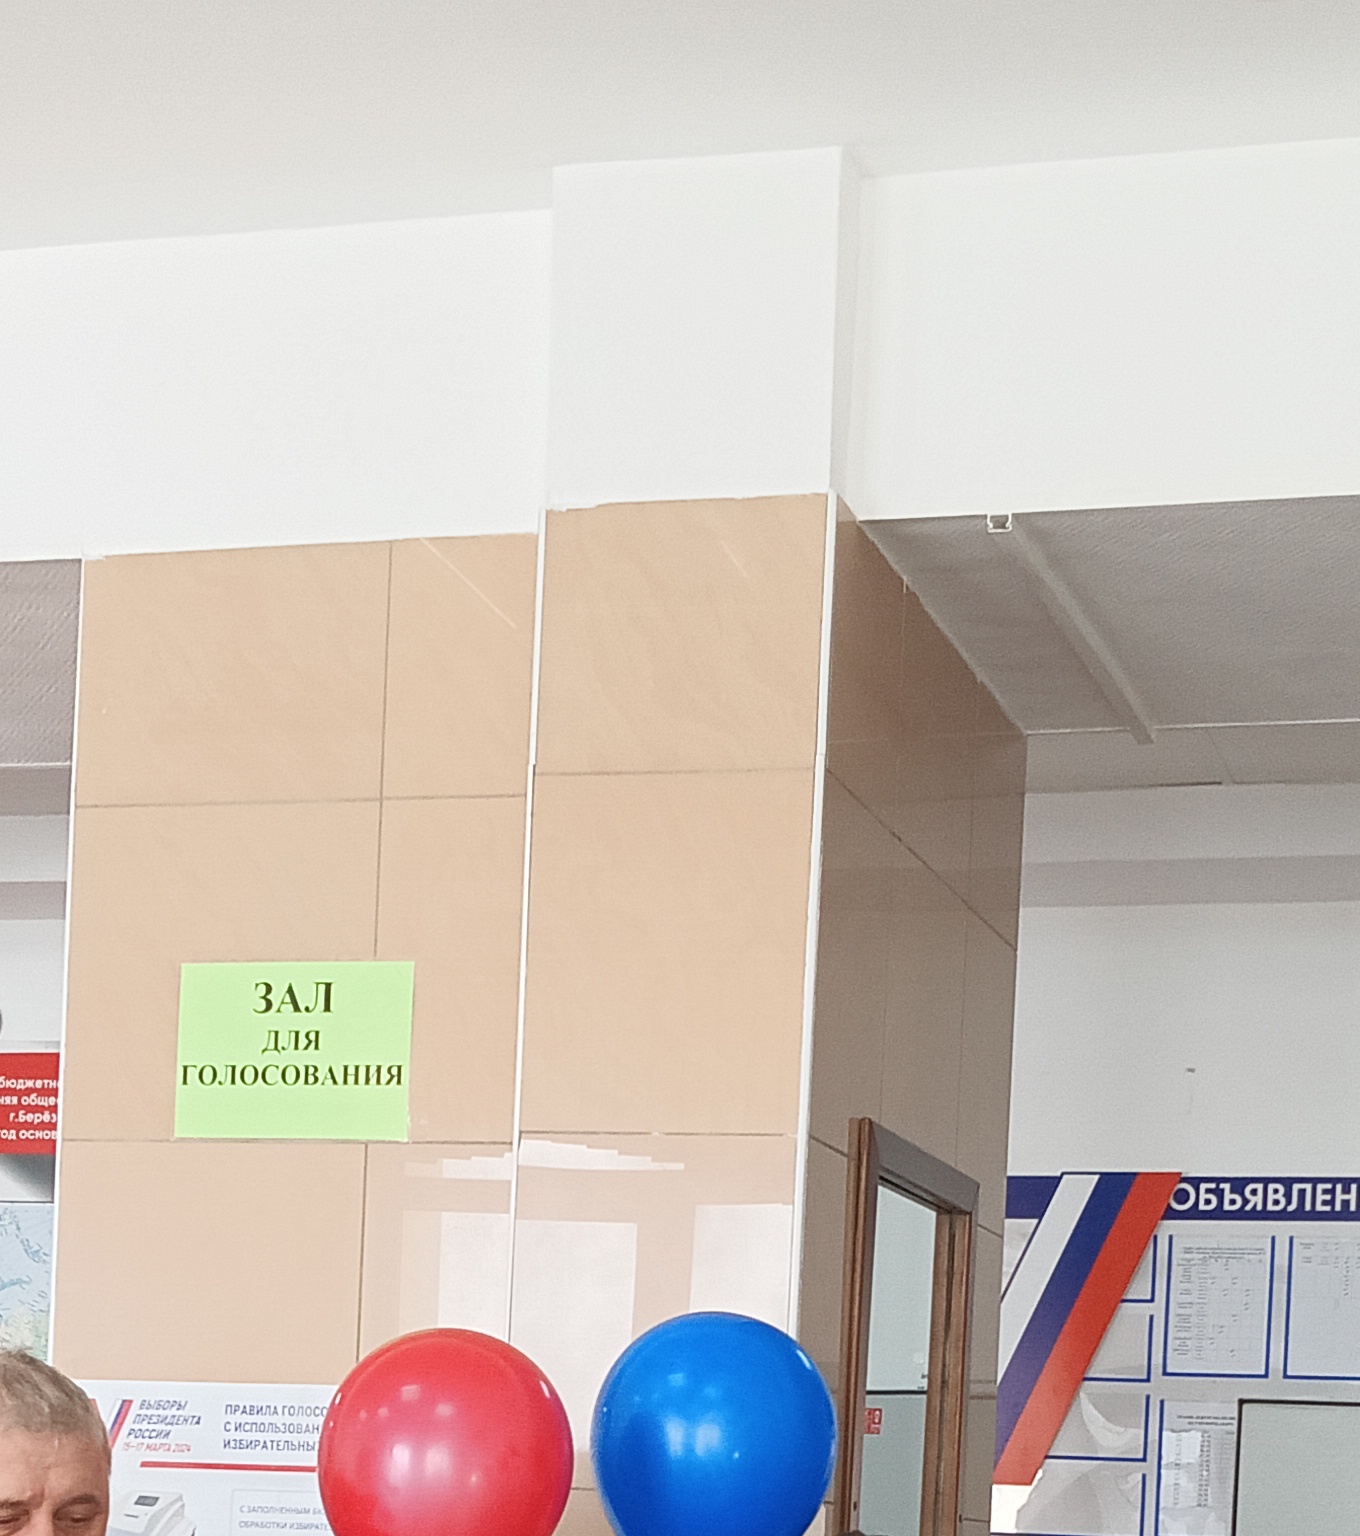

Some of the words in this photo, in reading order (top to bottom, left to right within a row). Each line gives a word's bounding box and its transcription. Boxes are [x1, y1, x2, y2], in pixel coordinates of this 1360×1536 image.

[253, 981, 335, 1014] ЗАЛ
[261, 1030, 320, 1055] ДЛЯ
[181, 1064, 403, 1086] ГОЛОСОВАНИЯ
[138, 1399, 189, 1412] ВЫБОРЫ
[224, 1404, 280, 1417] ПРАВИЛА
[132, 1413, 202, 1427] ПРЕЗИДЕНТА
[126, 1428, 172, 1440] РОССИИ
[223, 1421, 232, 1432] С
[234, 1422, 321, 1434] ИСПОЛЬЗОВАН
[223, 1438, 319, 1452] ИЗБИРАТЕЛЬНЫ
[238, 1521, 287, 1531] ОБРАБОТКИ
